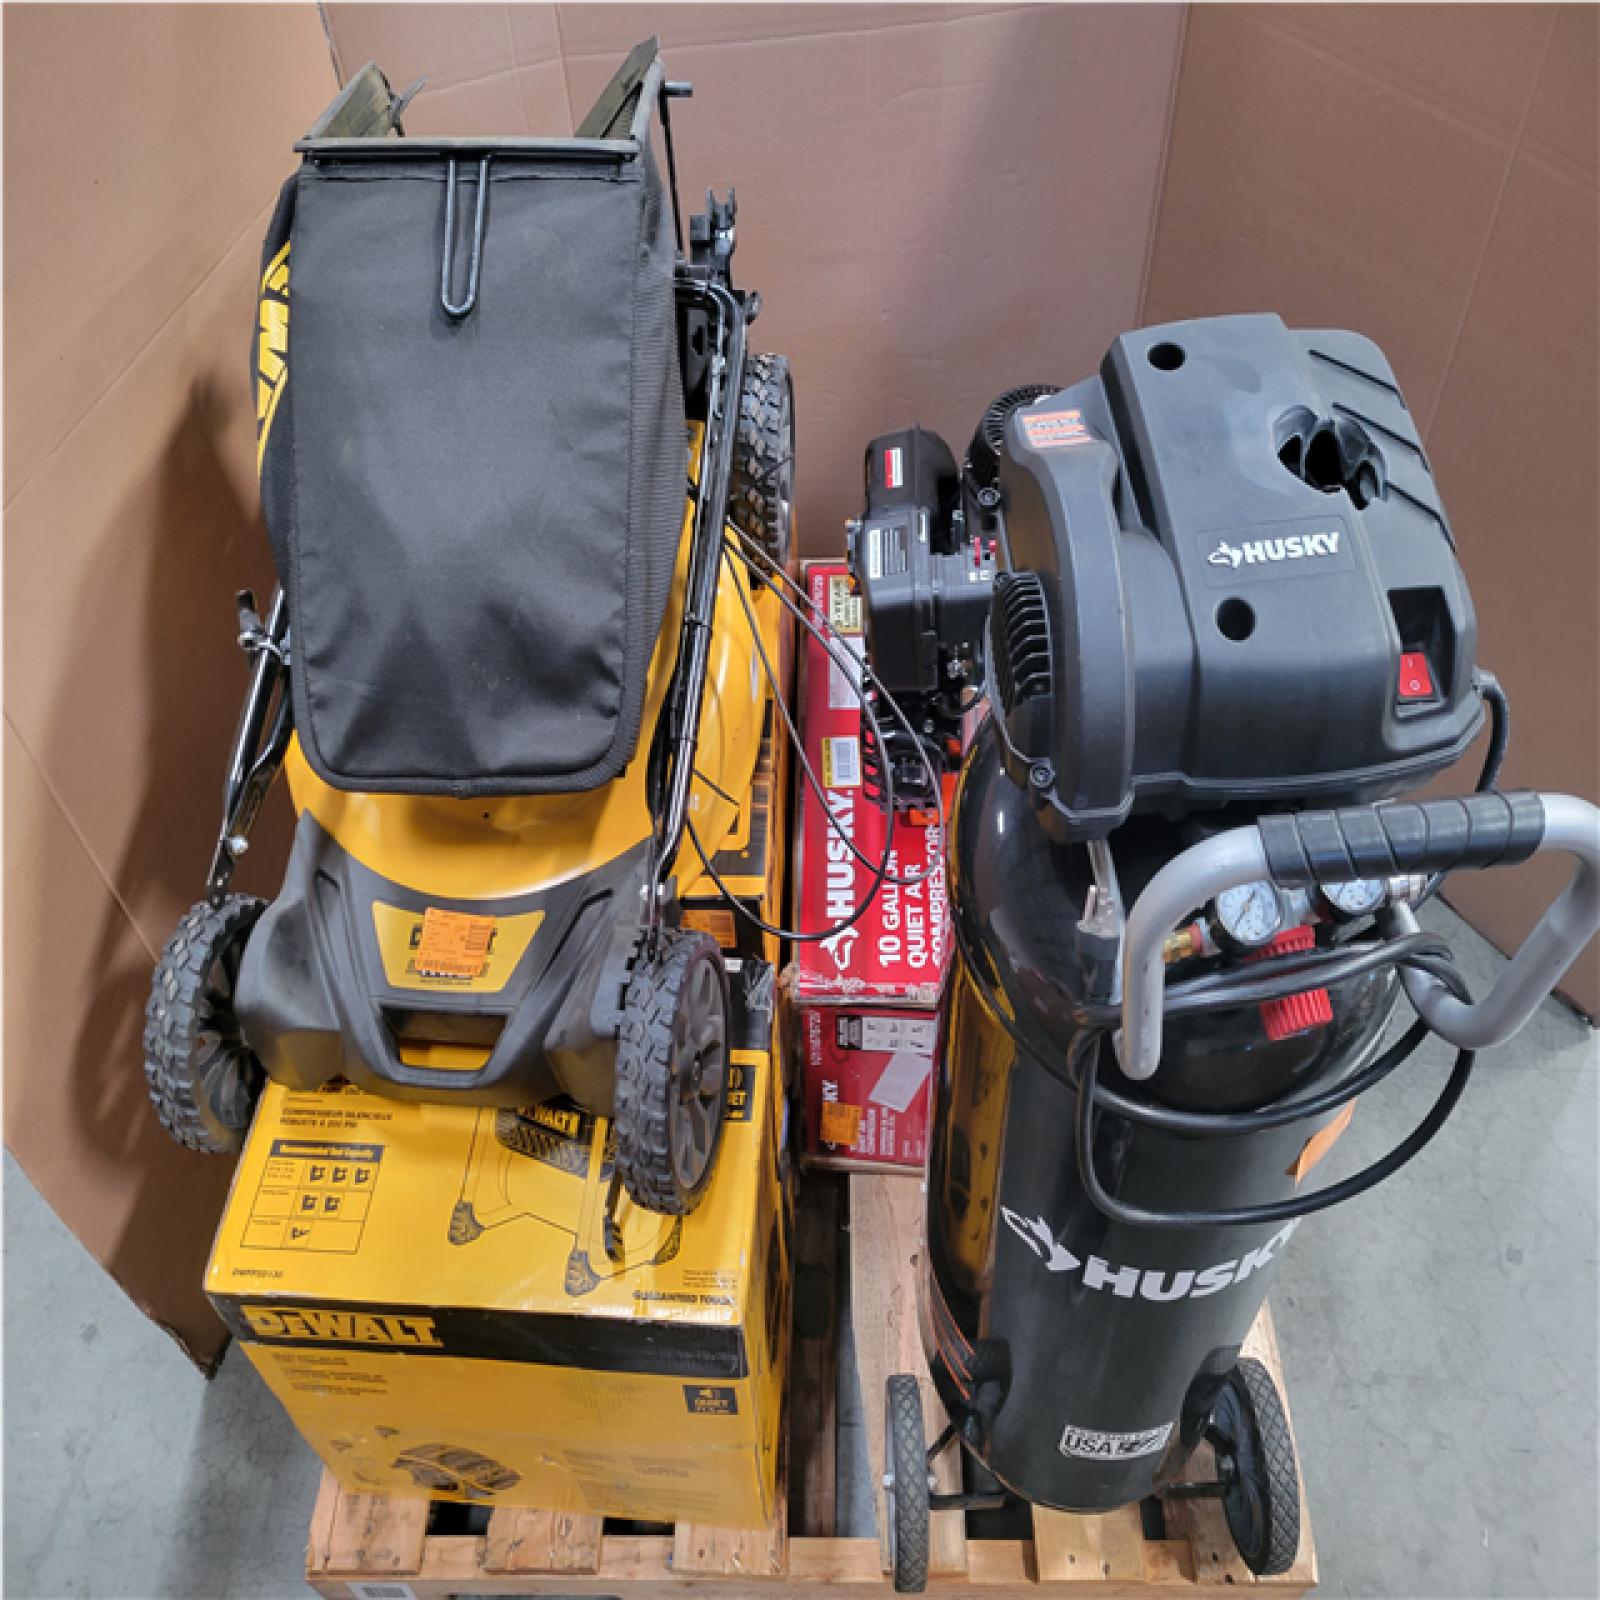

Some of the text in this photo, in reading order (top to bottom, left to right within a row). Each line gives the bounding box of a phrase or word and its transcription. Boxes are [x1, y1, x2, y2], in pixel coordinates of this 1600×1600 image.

[1242, 531, 1340, 564] HUSKY
[827, 794, 855, 917] HUSKY
[880, 934, 900, 967] 10
[904, 904, 928, 968] QUIET
[241, 1306, 443, 1348] DEWALT
